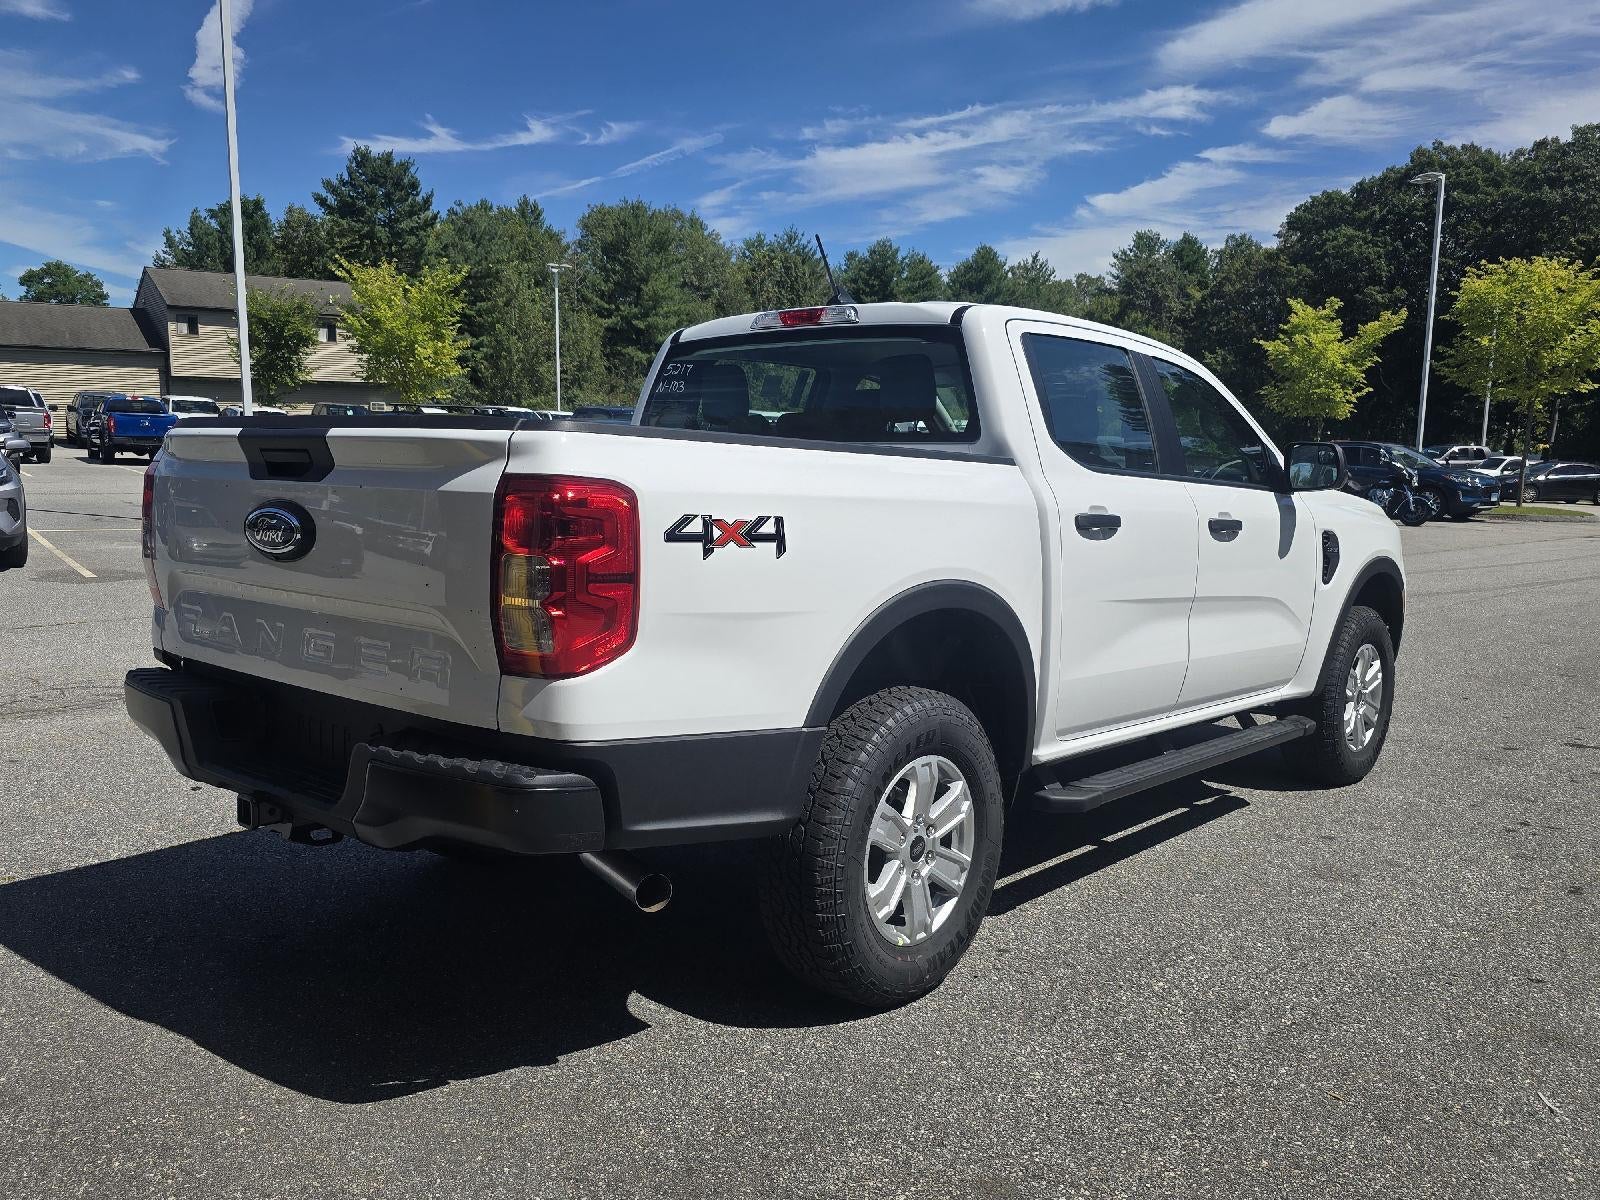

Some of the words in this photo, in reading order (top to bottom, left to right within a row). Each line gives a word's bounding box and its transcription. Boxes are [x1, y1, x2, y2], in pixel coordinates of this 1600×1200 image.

[662, 363, 694, 377] 5217
[655, 380, 686, 393] N-103
[254, 517, 285, 543] Ford
[179, 602, 453, 690] RANGER
